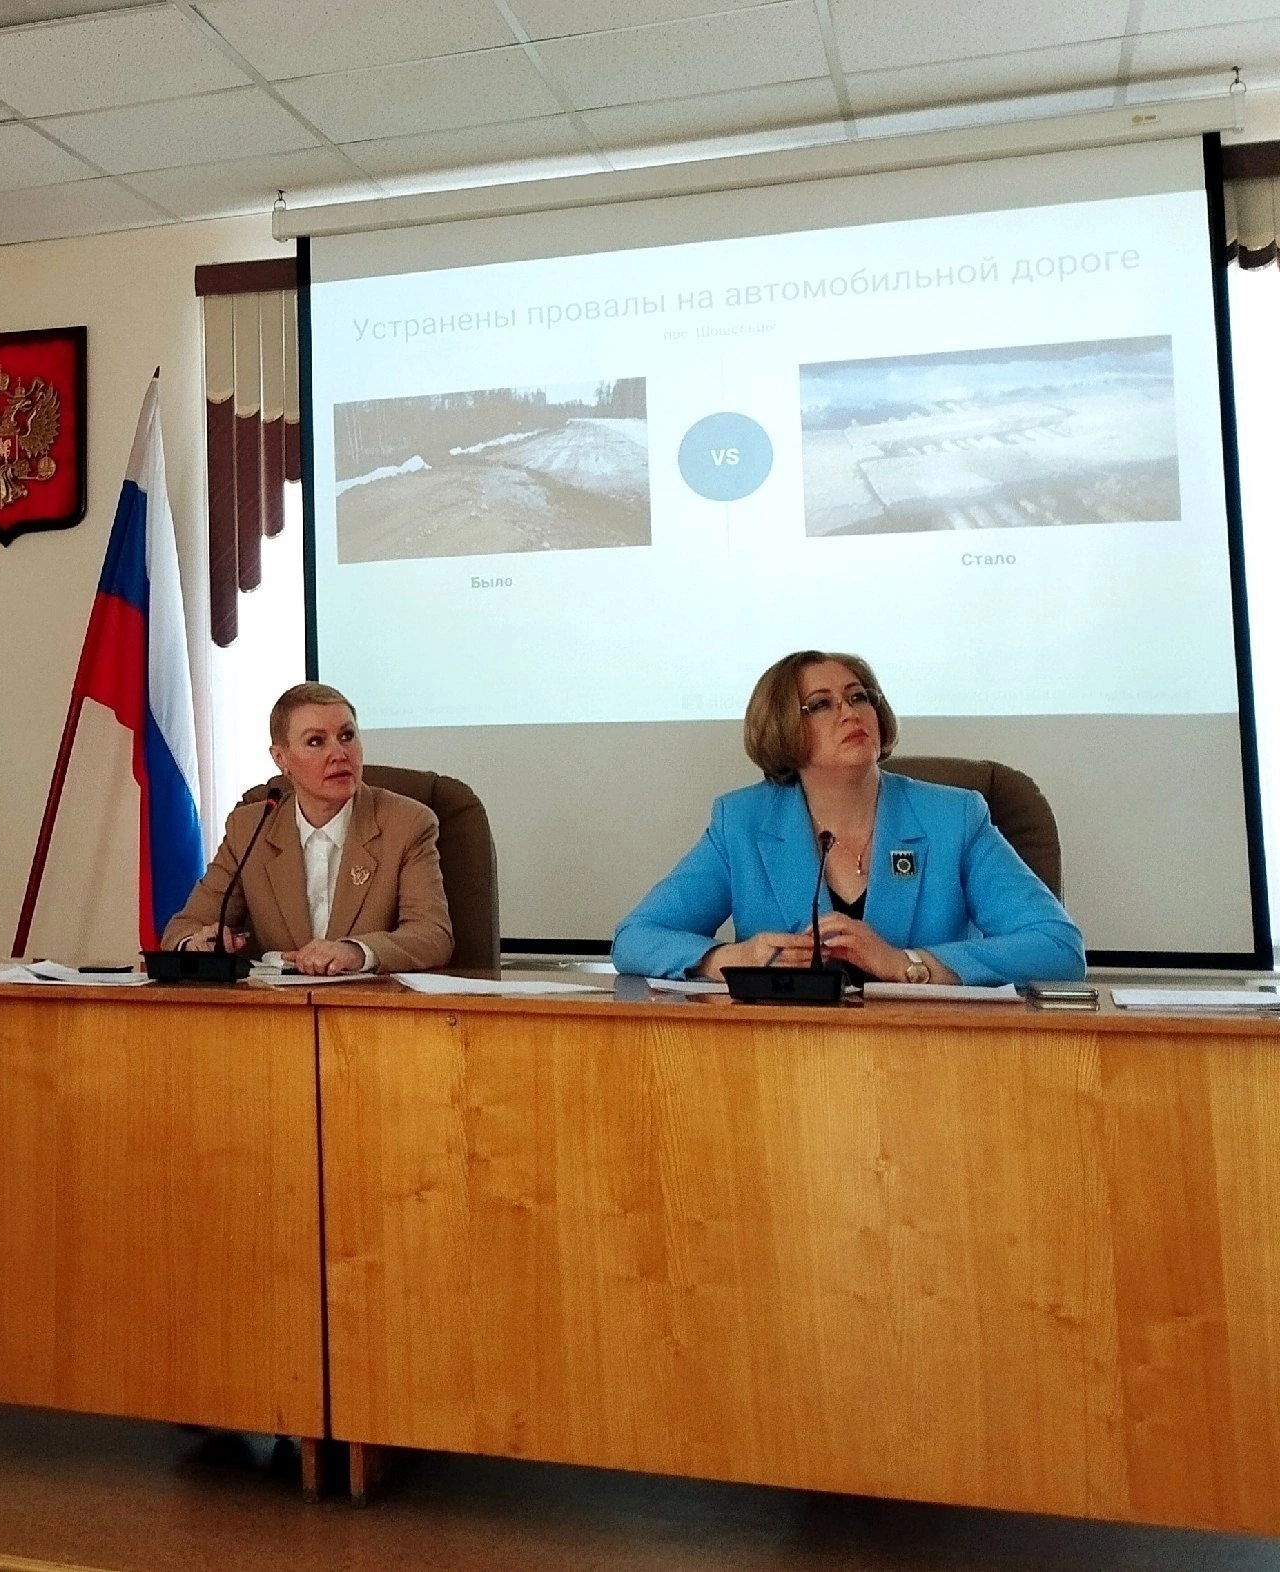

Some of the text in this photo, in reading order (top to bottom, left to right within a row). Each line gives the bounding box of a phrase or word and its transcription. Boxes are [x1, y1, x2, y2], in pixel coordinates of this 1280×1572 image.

[352, 247, 1142, 343] Устранены провалы на автомобильной дороге
[960, 552, 1017, 567] Стало
[470, 576, 514, 589] Было
